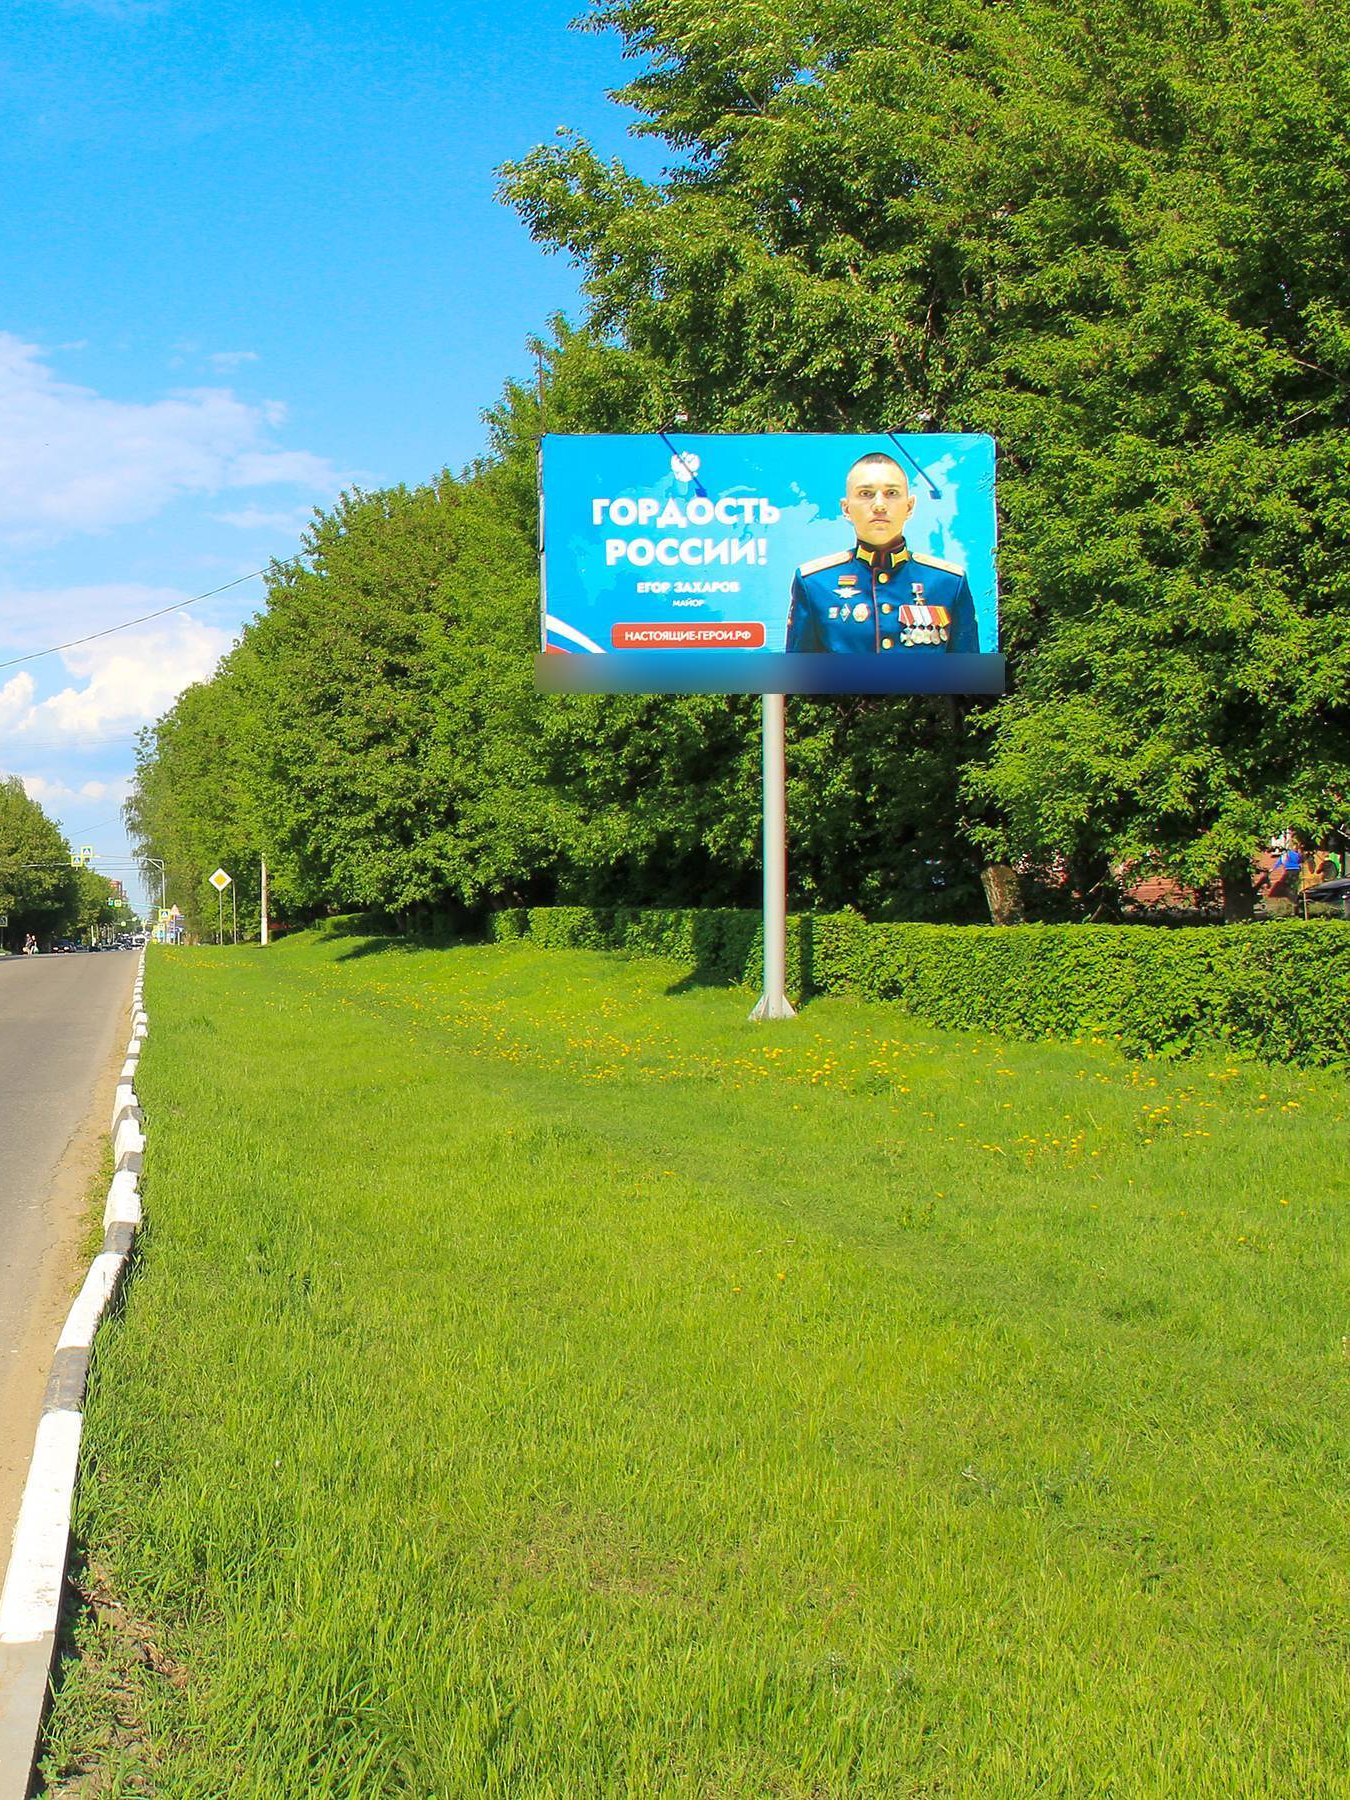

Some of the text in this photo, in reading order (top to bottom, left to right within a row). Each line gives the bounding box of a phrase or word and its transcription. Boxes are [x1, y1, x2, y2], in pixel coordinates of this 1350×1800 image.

[592, 497, 781, 528] ГОРДОСТЬ
[605, 538, 768, 567] РОССИИ!
[636, 581, 740, 593] ЕГОР ЗАХАРОВ
[672, 597, 705, 607] МАЙОР
[624, 630, 752, 642] НАСТОЯЩИЕ-ГЕРОИ.РФ
